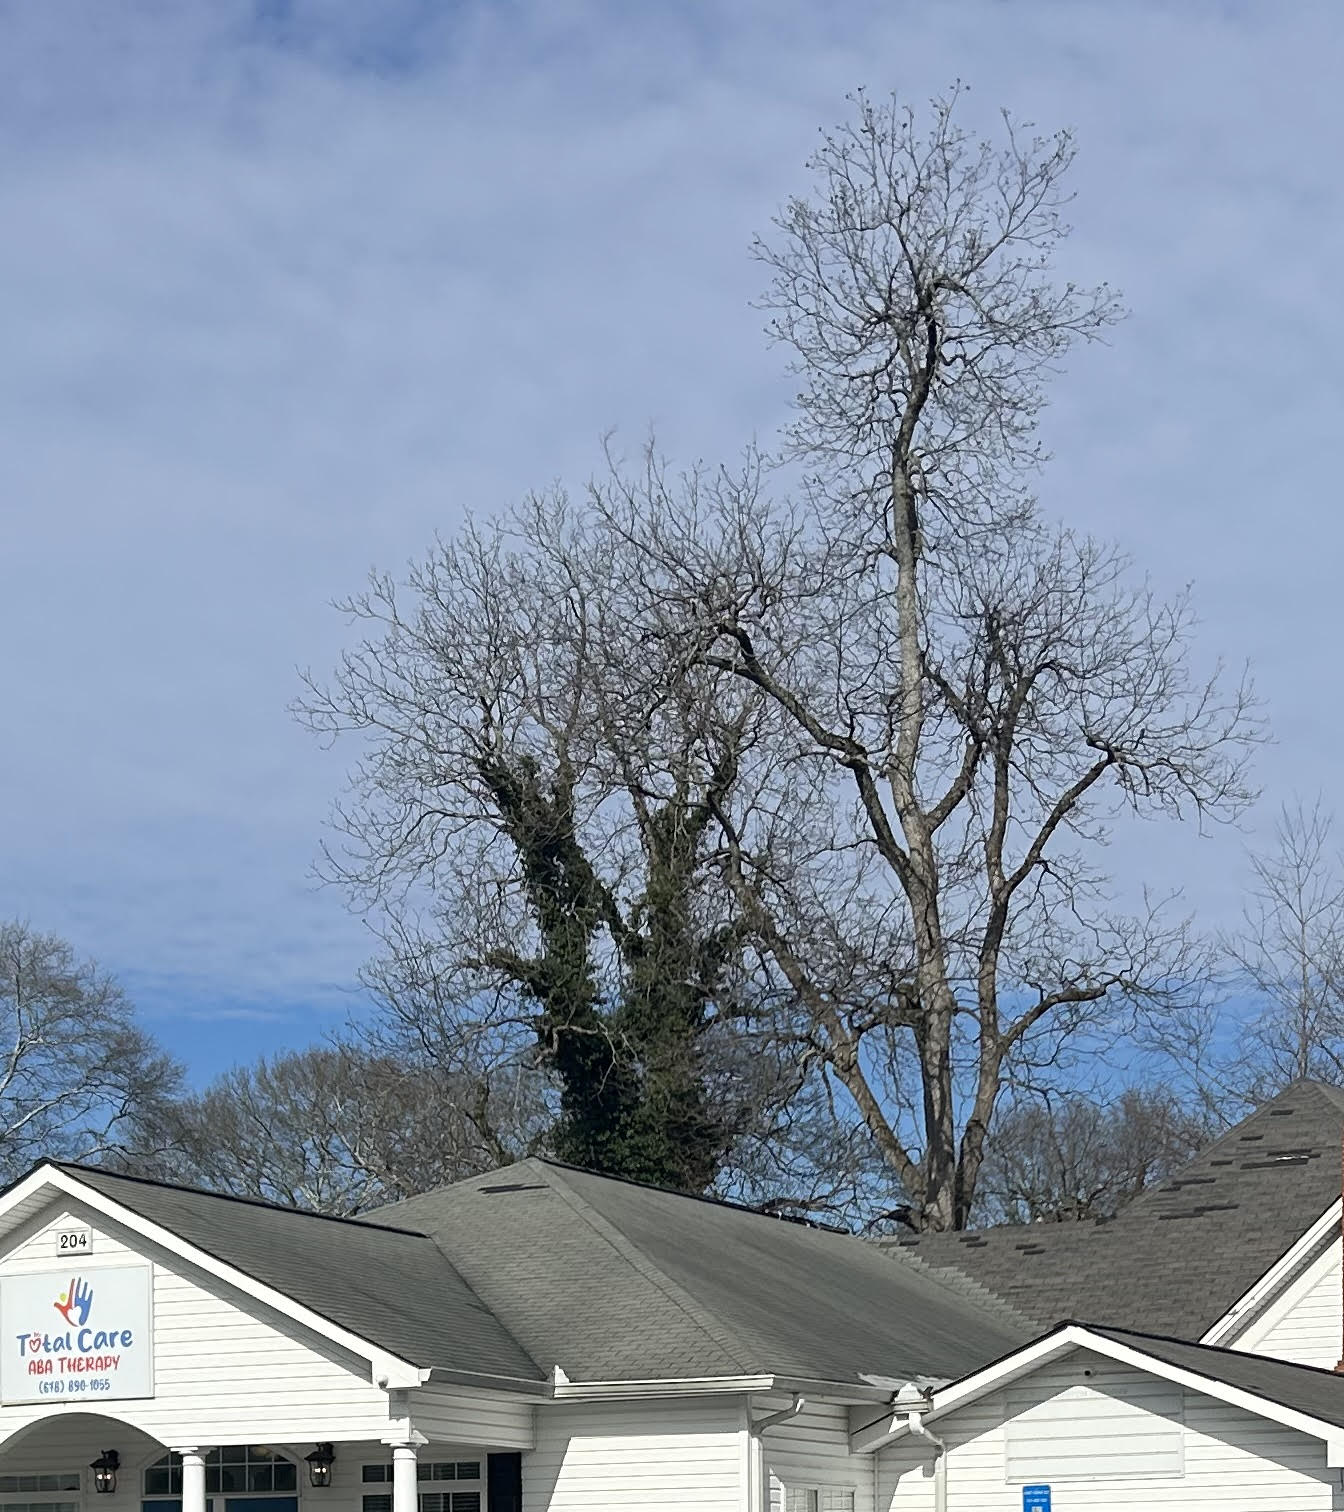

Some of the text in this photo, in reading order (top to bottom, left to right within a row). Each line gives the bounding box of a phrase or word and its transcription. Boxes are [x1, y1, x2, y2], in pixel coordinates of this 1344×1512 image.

[60, 1234, 87, 1249] 204
[16, 1328, 133, 1356] Total Care
[28, 1355, 120, 1375] ABA THERAPY
[38, 1378, 111, 1394] (678) 890-1055
